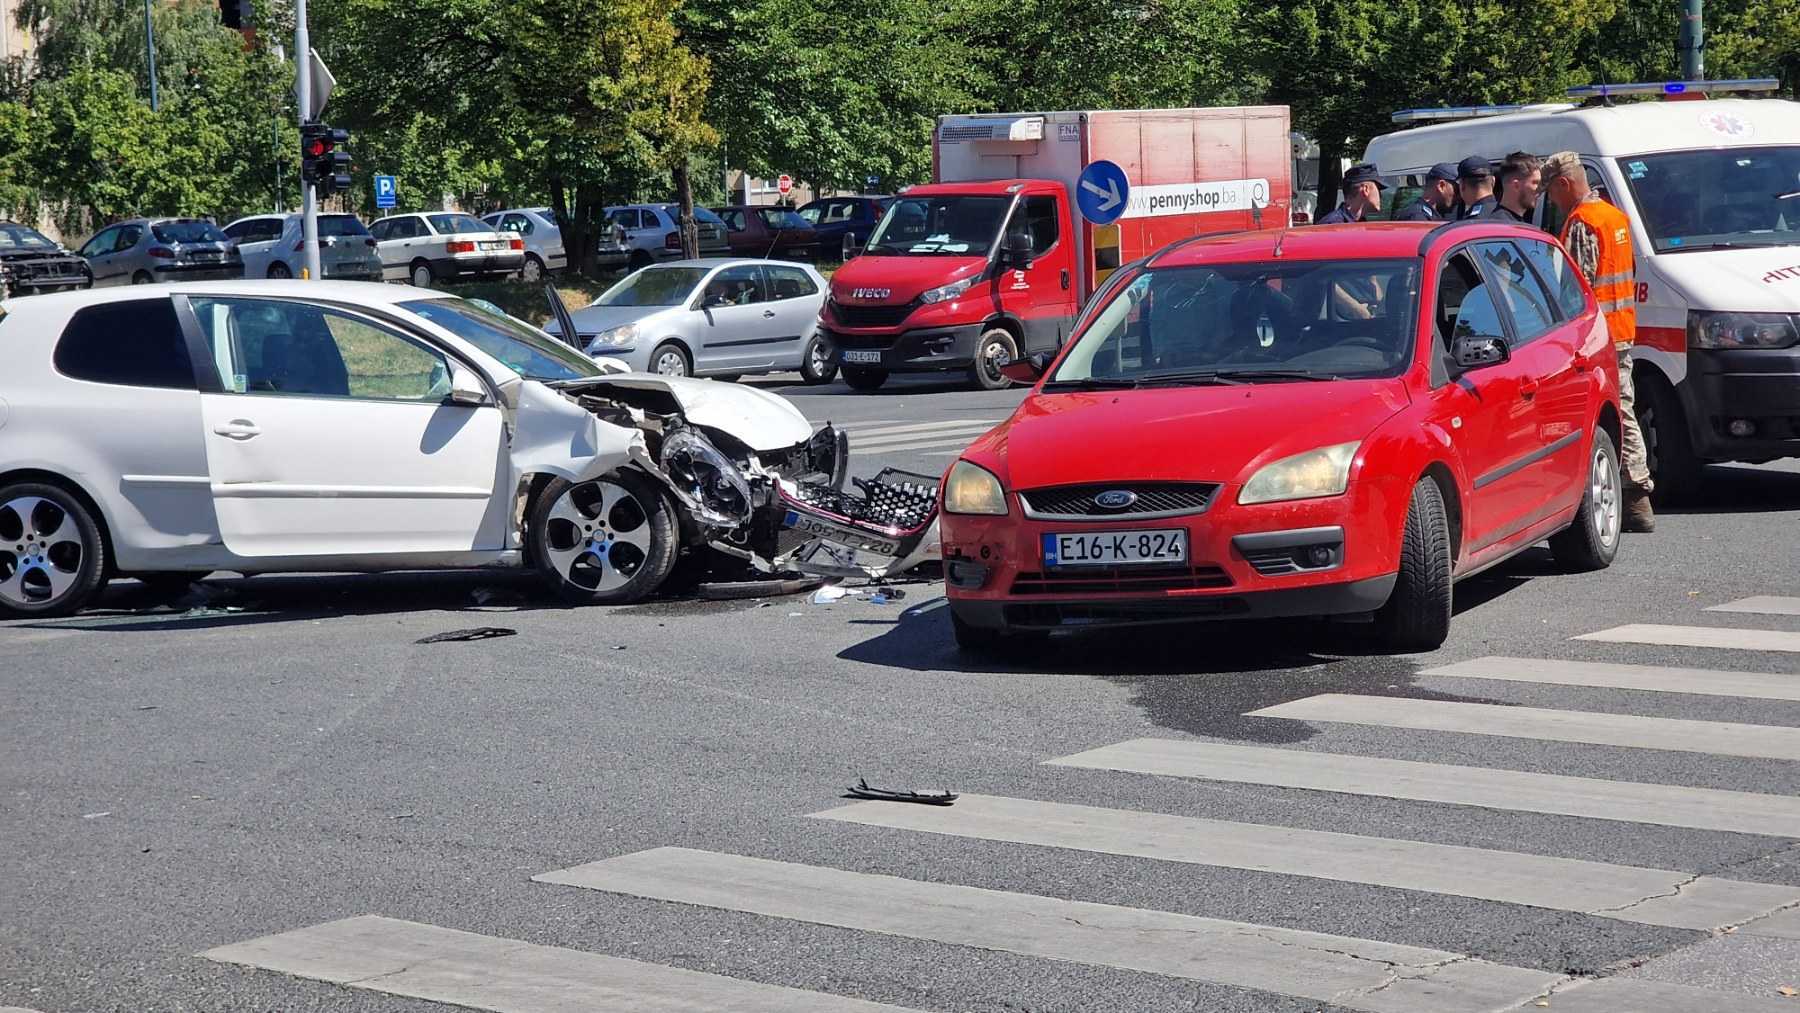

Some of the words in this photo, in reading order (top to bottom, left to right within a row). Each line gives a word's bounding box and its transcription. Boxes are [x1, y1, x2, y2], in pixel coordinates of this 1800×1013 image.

[380, 179, 391, 196] P
[852, 288, 891, 298] IVECO
[1103, 494, 1125, 504] Ford
[1060, 533, 1181, 560] E16-K-824
